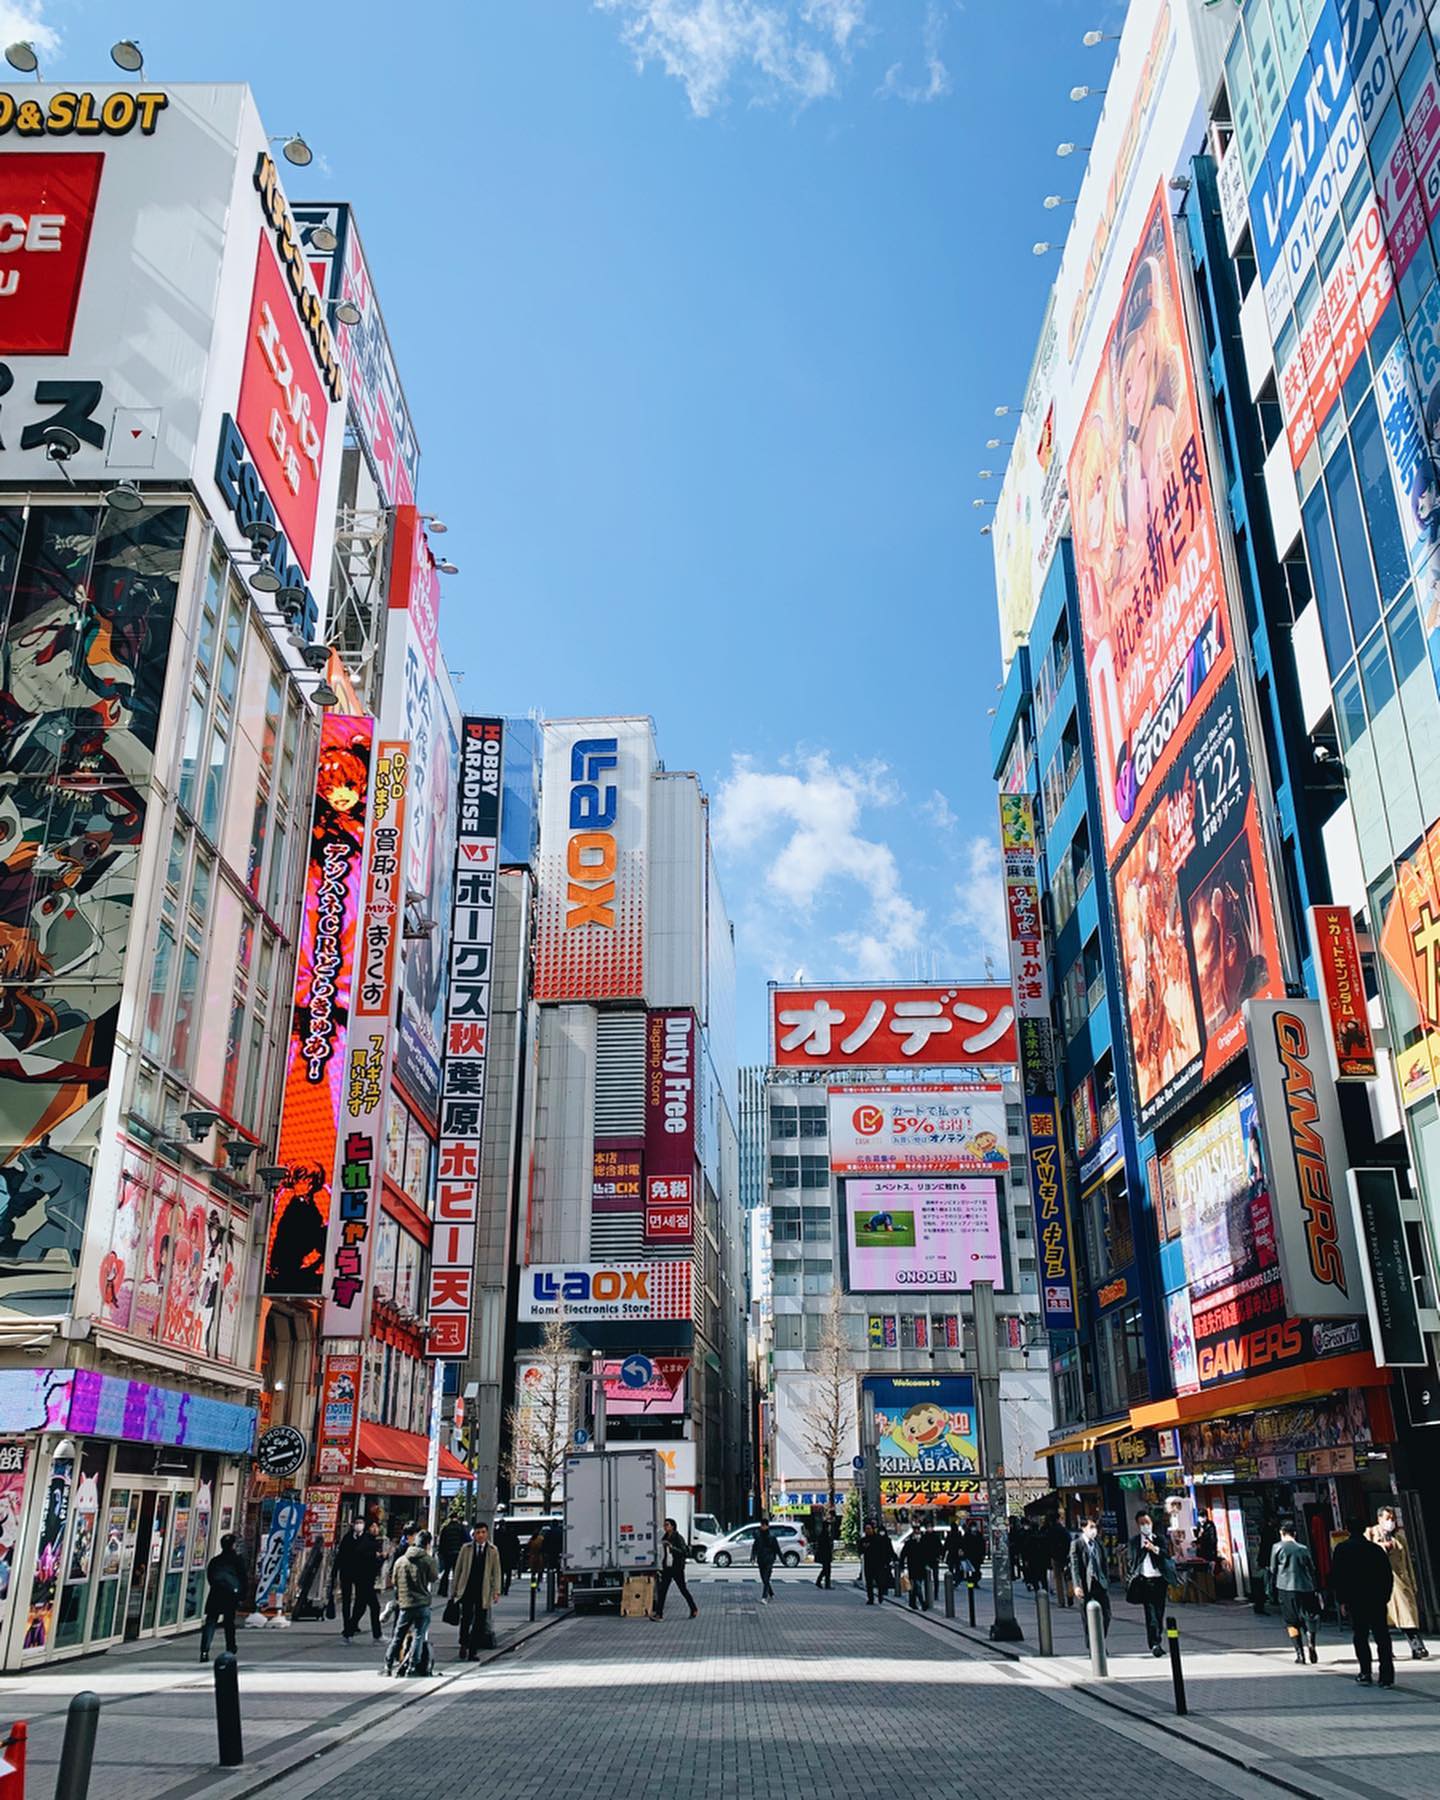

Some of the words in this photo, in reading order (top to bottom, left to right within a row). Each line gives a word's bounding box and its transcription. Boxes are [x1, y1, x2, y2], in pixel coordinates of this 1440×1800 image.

[257, 300, 318, 481] エスパス
[392, 753, 406, 799] DVD
[462, 724, 481, 832] PARADISE
[482, 724, 500, 796] HOBBY
[1197, 737, 1241, 826] 1.22
[371, 829, 399, 892] 買取り
[363, 925, 389, 1006] まっくす
[1021, 941, 1042, 999] 耳かき
[1328, 923, 1353, 1015] カードキングダム
[650, 1017, 663, 1068] Flagship
[662, 1016, 692, 1074] Duty
[778, 989, 1015, 1057] オノデン
[651, 1071, 663, 1106] Store
[664, 1077, 691, 1135] Free
[892, 1105, 971, 1116] カードで払って
[892, 1118, 934, 1133] 5%
[1273, 1010, 1349, 1299] GAMERS
[651, 1180, 688, 1199] 免税
[1033, 1145, 1065, 1277] マツモトキヨシ
[650, 1214, 689, 1229] 면세점
[896, 1270, 957, 1283] ONODEN
[622, 1303, 650, 1313] Store
[662, 1363, 683, 1372] 止まれ
[1199, 1318, 1304, 1382] GAMERS
[875, 1457, 975, 1474] KIHABARA
